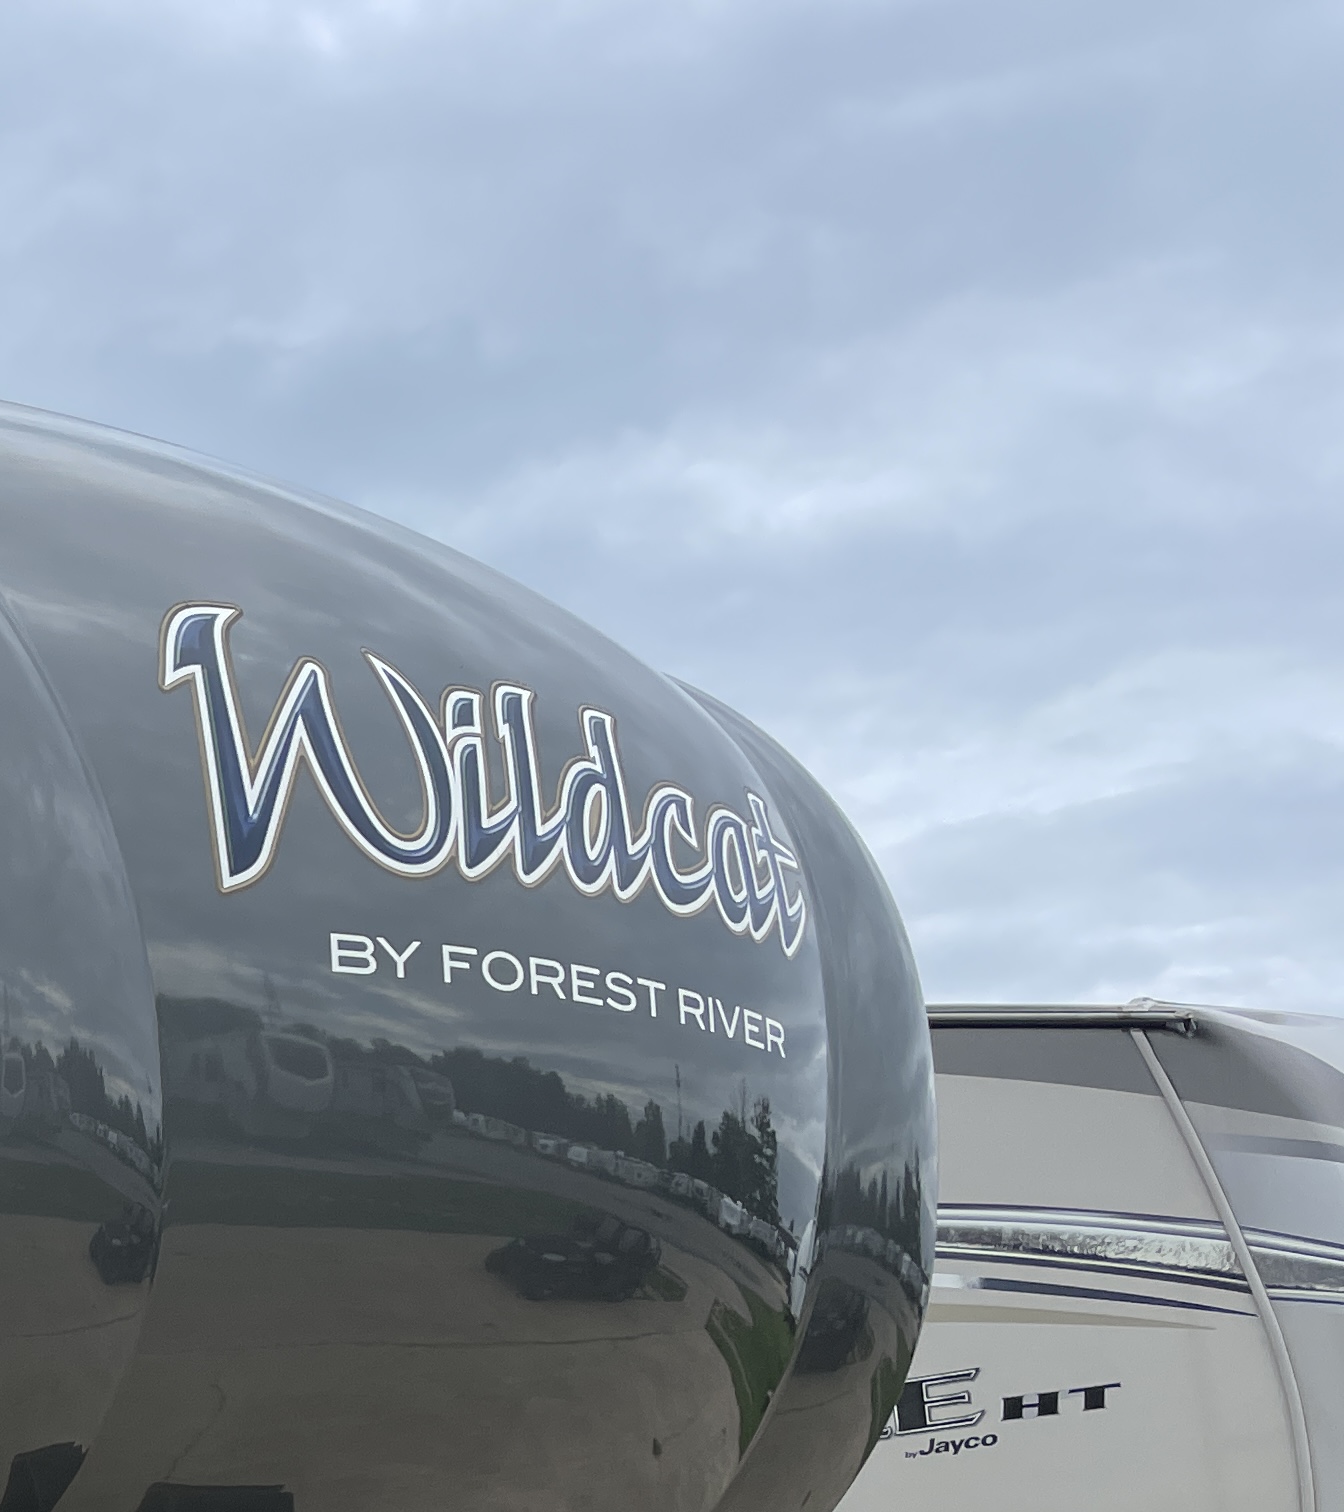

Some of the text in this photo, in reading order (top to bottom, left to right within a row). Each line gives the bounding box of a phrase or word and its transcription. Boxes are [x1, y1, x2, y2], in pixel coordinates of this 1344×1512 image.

[159, 601, 806, 960] Wildcat
[330, 932, 786, 1059] BY FOREST RIVER
[1000, 1382, 1121, 1422] HT
[904, 1433, 999, 1459] by Jayco
